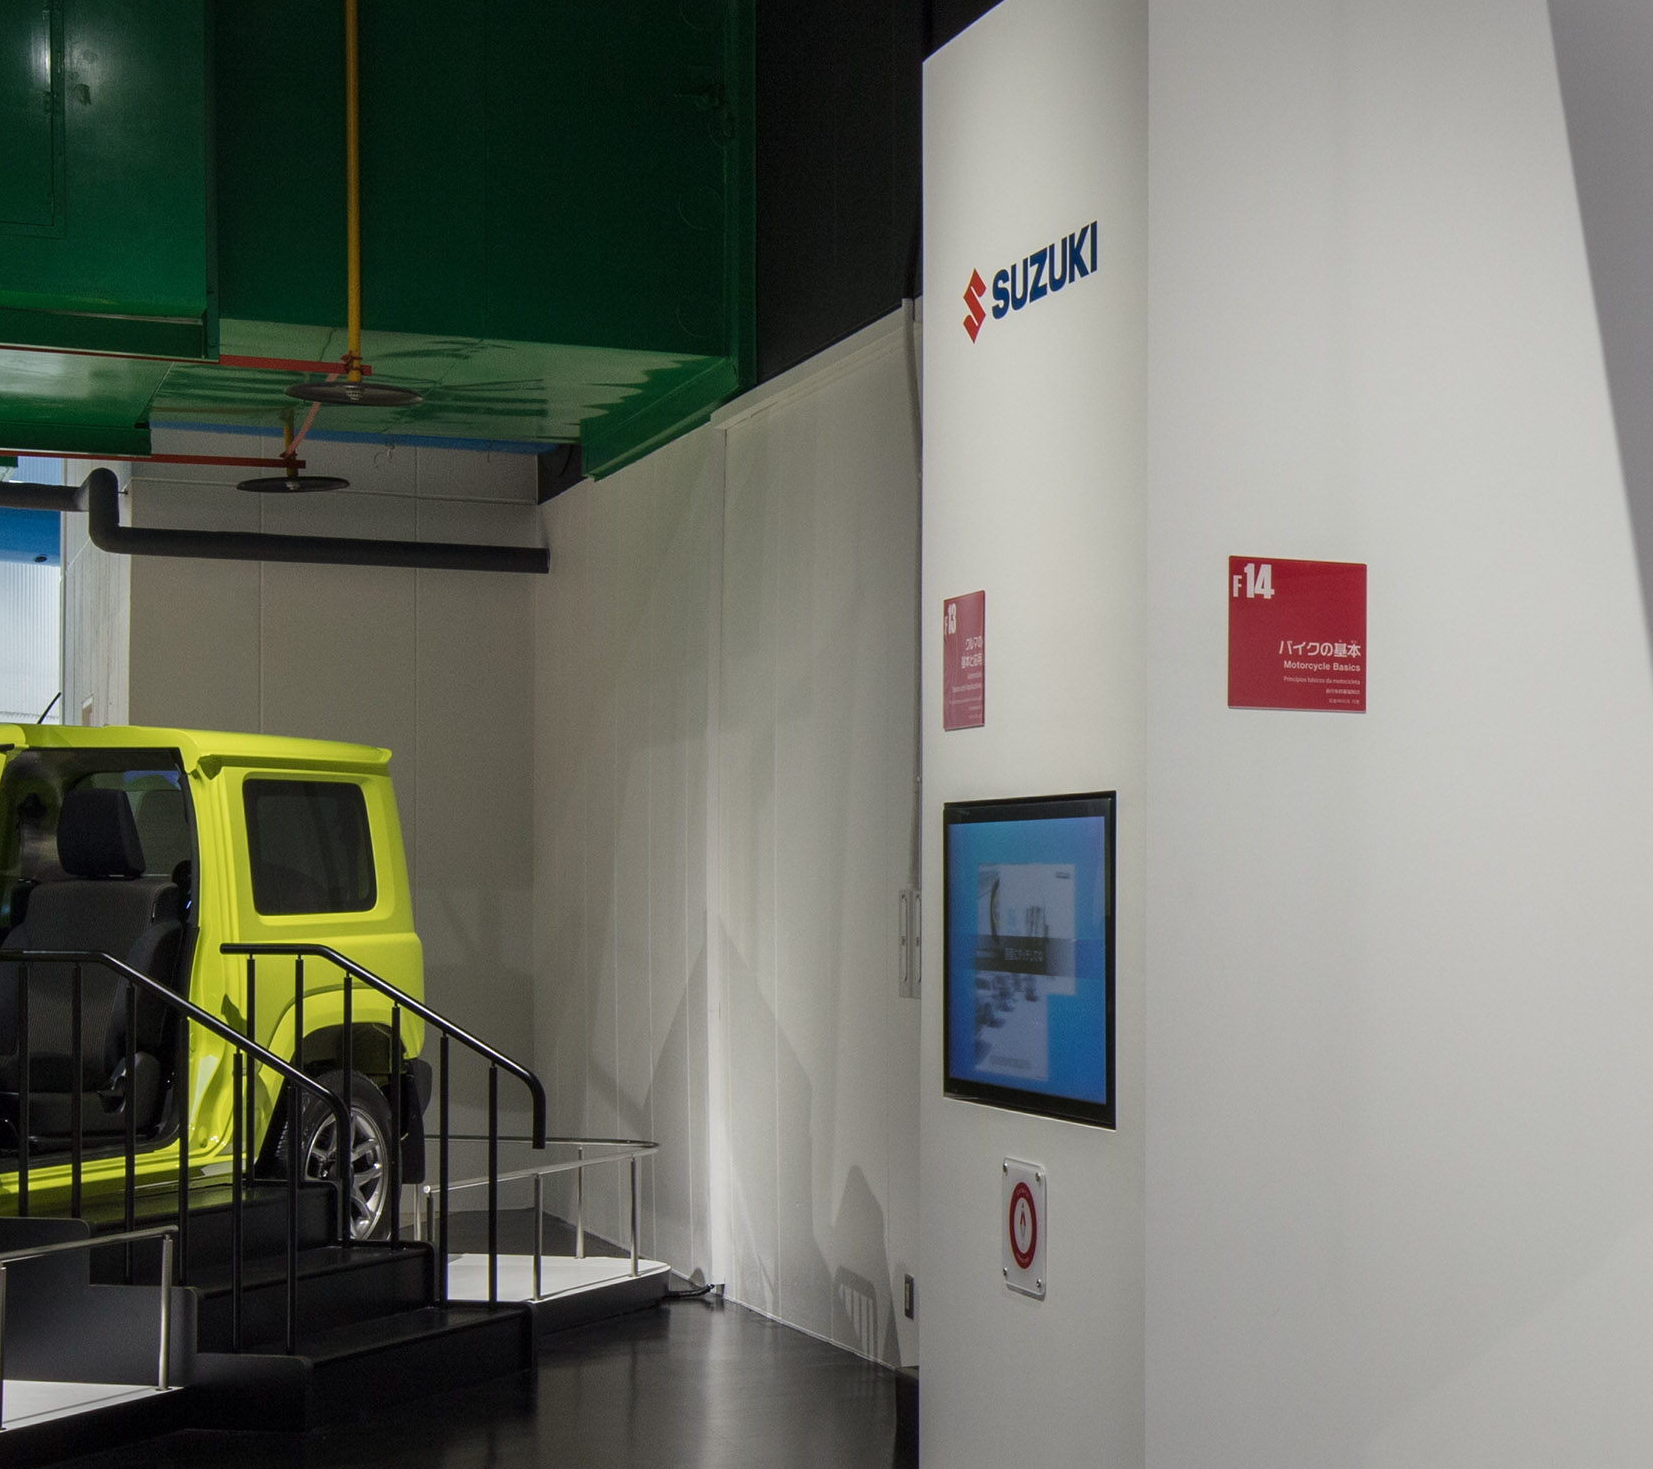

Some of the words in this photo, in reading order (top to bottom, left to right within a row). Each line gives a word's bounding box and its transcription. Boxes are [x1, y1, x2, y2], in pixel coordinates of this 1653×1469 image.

[991, 220, 1099, 320] SUZUKI
[1278, 640, 1362, 658] バイクの基本
[1283, 660, 1331, 672] Motorcycle
[1332, 662, 1361, 672] Basics
